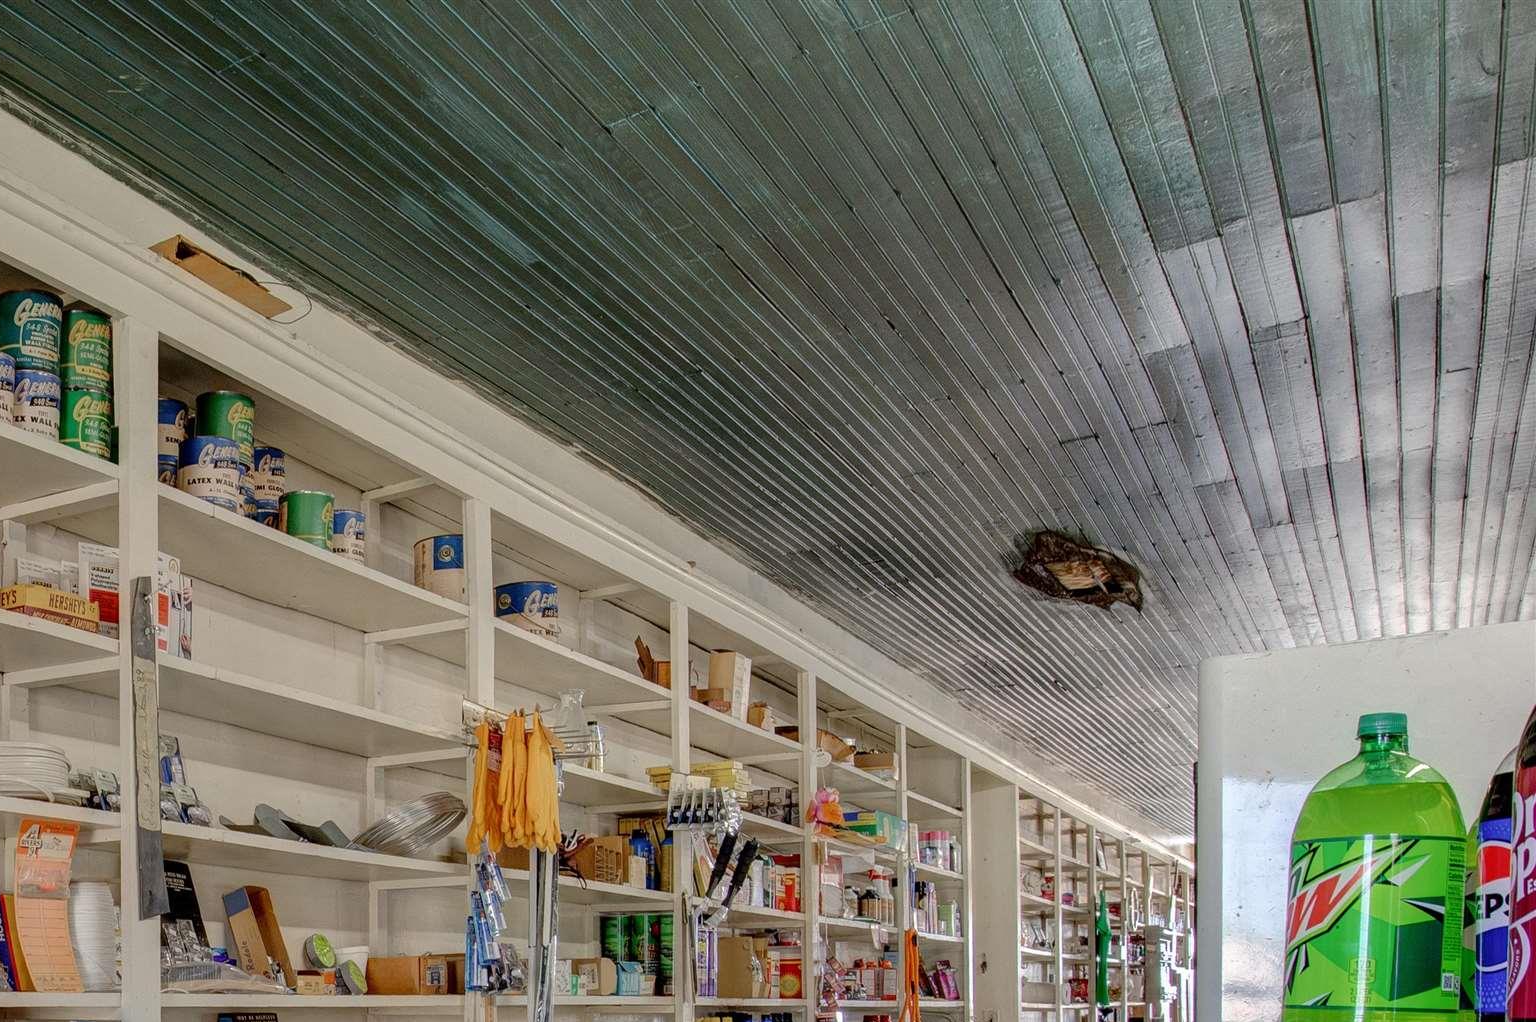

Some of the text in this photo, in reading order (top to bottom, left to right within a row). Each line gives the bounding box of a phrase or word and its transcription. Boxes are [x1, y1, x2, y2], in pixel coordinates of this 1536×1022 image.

[30, 416, 52, 428] WALL
[187, 477, 212, 486] LATEX
[48, 593, 86, 616] HERSHEY'S
